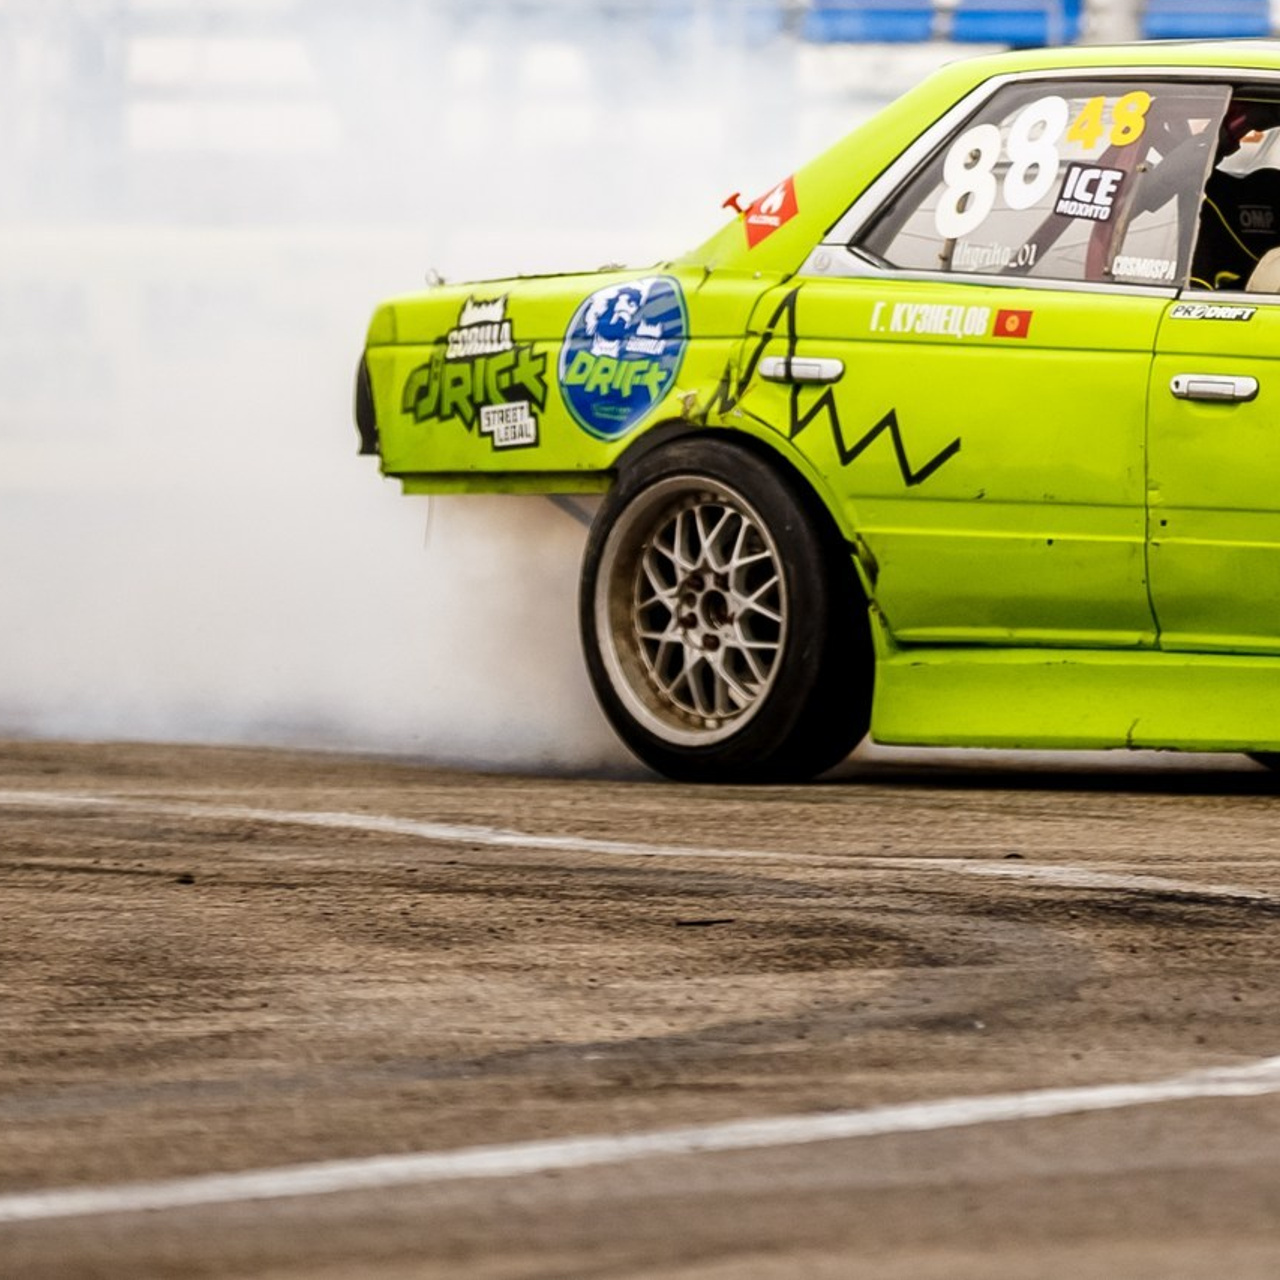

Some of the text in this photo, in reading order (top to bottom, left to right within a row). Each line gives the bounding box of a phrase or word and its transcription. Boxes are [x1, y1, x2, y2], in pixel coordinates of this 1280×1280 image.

[1067, 91, 1151, 149] 48
[935, 96, 1069, 239] 88
[1063, 167, 1124, 206] ICE
[1240, 210, 1274, 228] OMP
[870, 301, 991, 339] Г. КУЗНЕЦОВ
[565, 350, 668, 403] DRIFT
[484, 405, 525, 428] STREET
[496, 419, 532, 442] LEGAL
